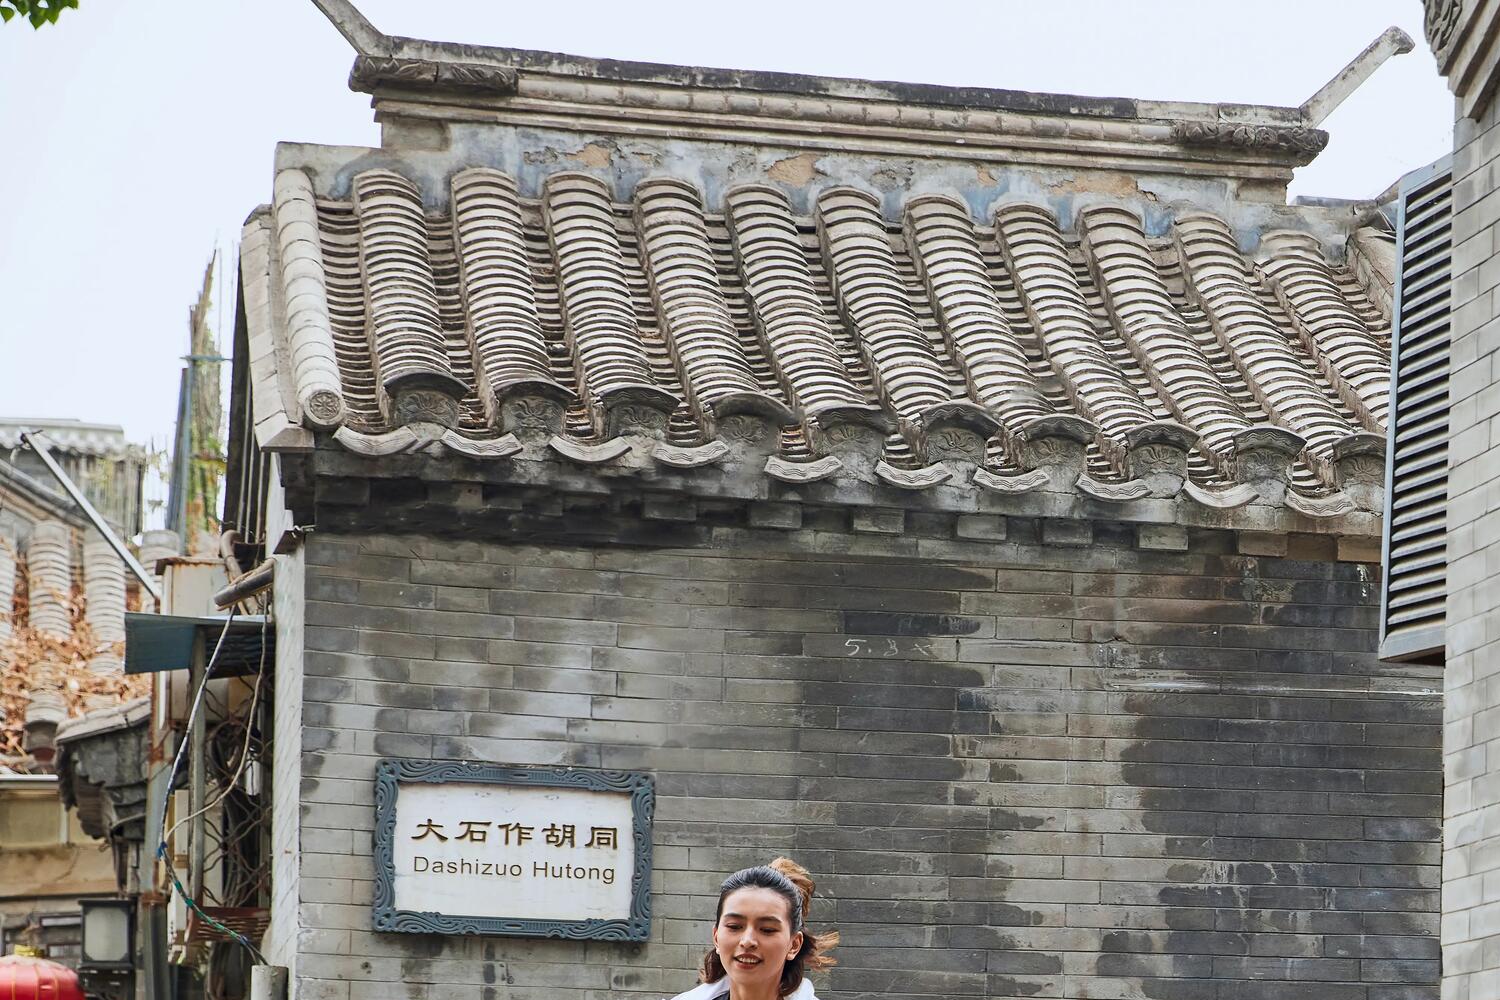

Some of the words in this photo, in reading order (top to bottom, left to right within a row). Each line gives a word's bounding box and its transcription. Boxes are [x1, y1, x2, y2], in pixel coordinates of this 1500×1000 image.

[411, 818, 619, 850] 大石作胡同
[413, 856, 522, 877] Dashizuo
[533, 861, 615, 885] Hutong
